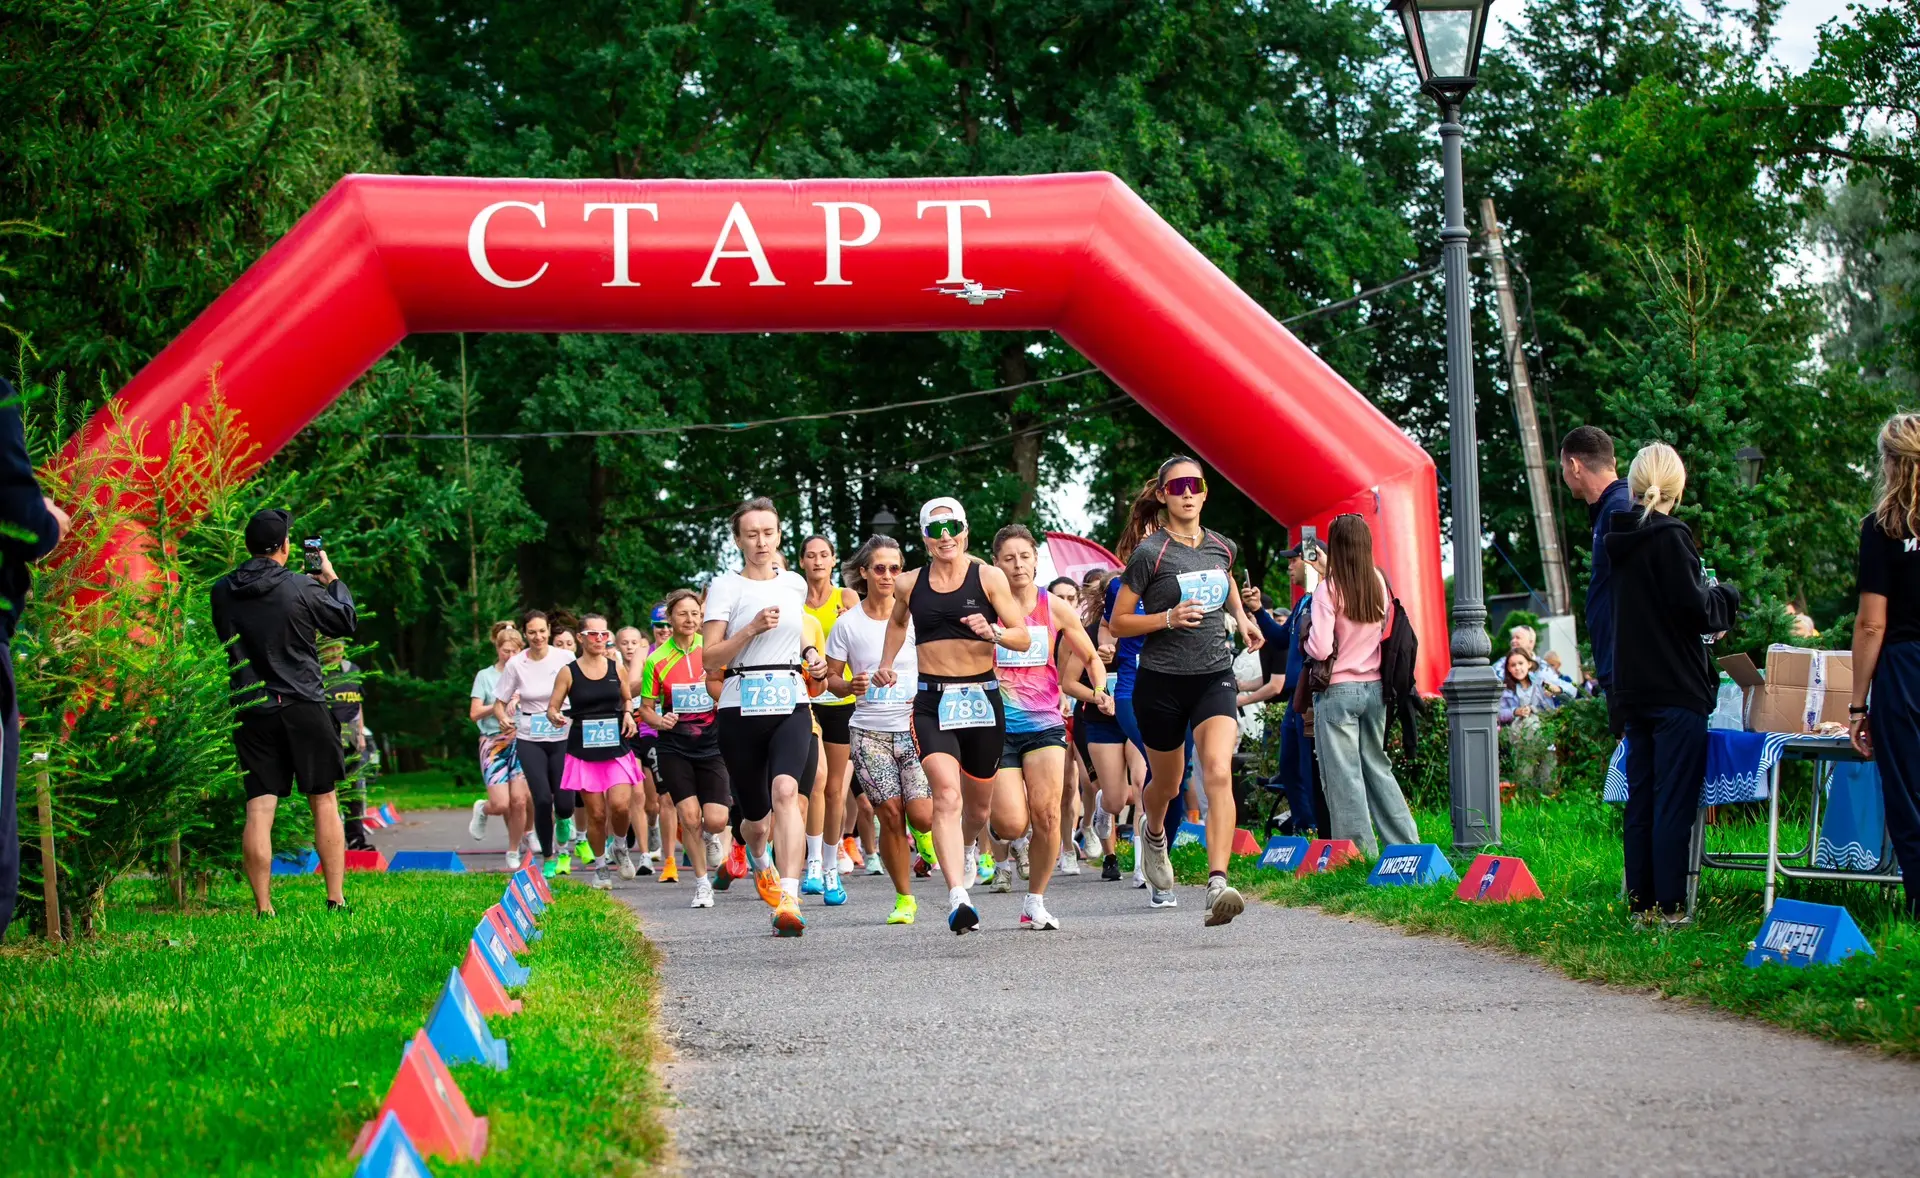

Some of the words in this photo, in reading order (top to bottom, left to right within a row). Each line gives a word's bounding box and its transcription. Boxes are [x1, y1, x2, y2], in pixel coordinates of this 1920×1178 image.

[466, 199, 992, 289] СТАРТ
[1903, 537, 1920, 553] И
[1188, 584, 1224, 604] 759
[678, 693, 709, 707] 786
[747, 685, 791, 706] 739
[945, 699, 987, 720] 789
[588, 728, 615, 741] 745
[1377, 855, 1422, 876] ИЖОРЕЦ
